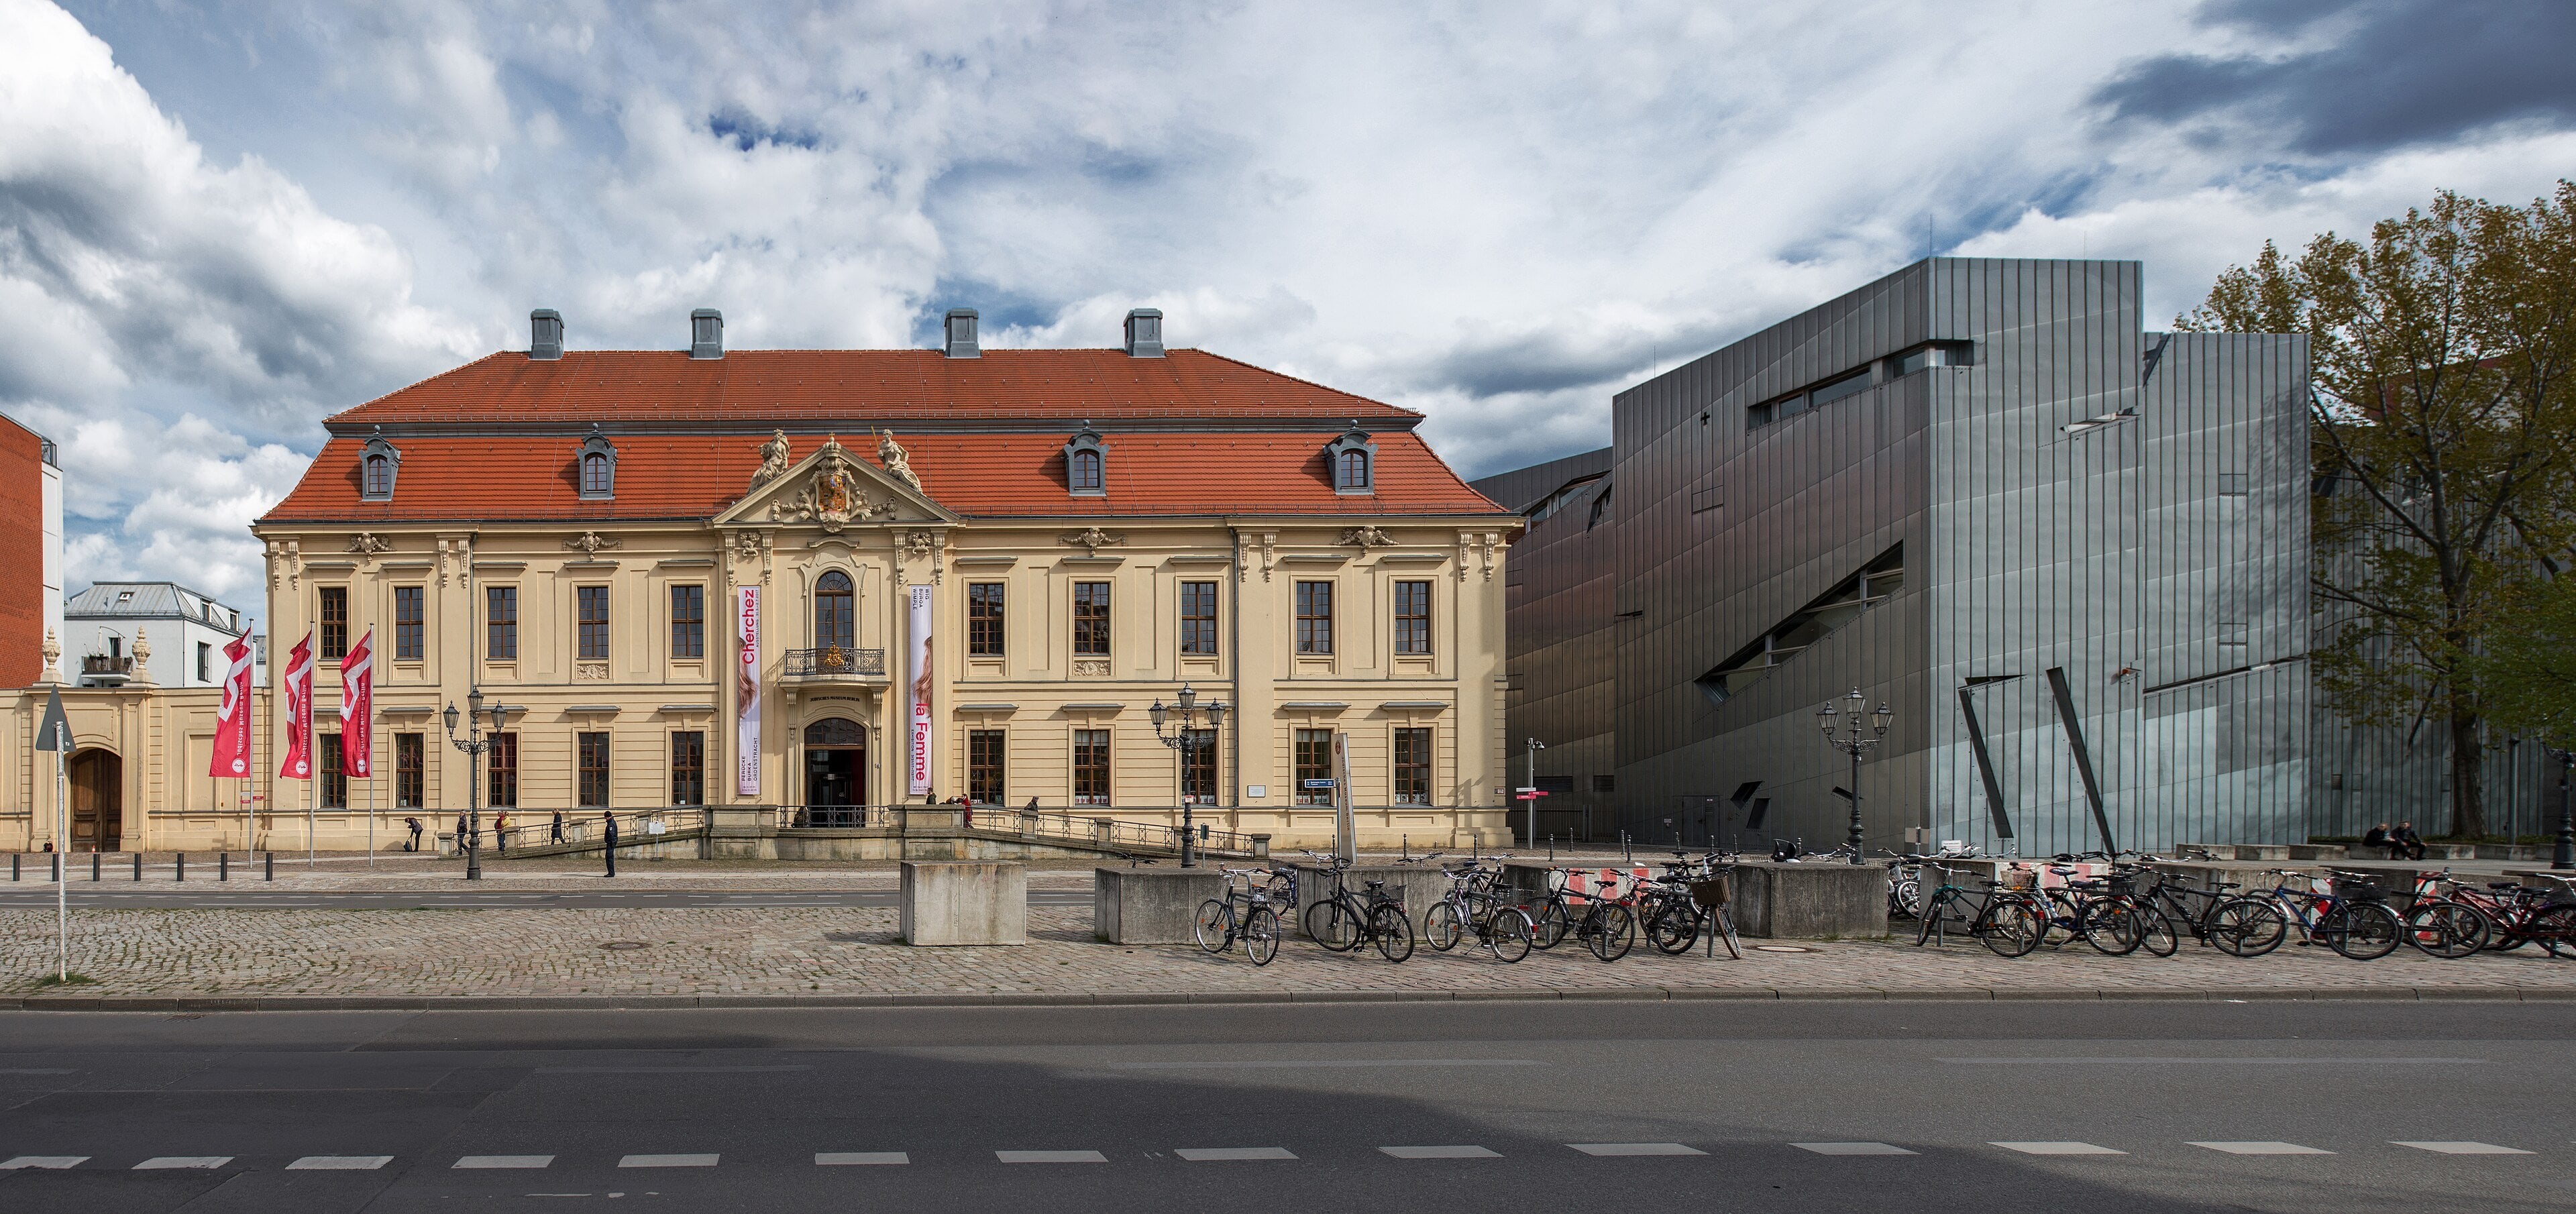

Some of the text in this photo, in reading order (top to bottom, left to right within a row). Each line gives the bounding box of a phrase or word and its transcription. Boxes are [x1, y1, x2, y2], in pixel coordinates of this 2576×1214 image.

[742, 590, 755, 664] Cherchez
[916, 703, 928, 716] la
[916, 723, 927, 780] Femme
